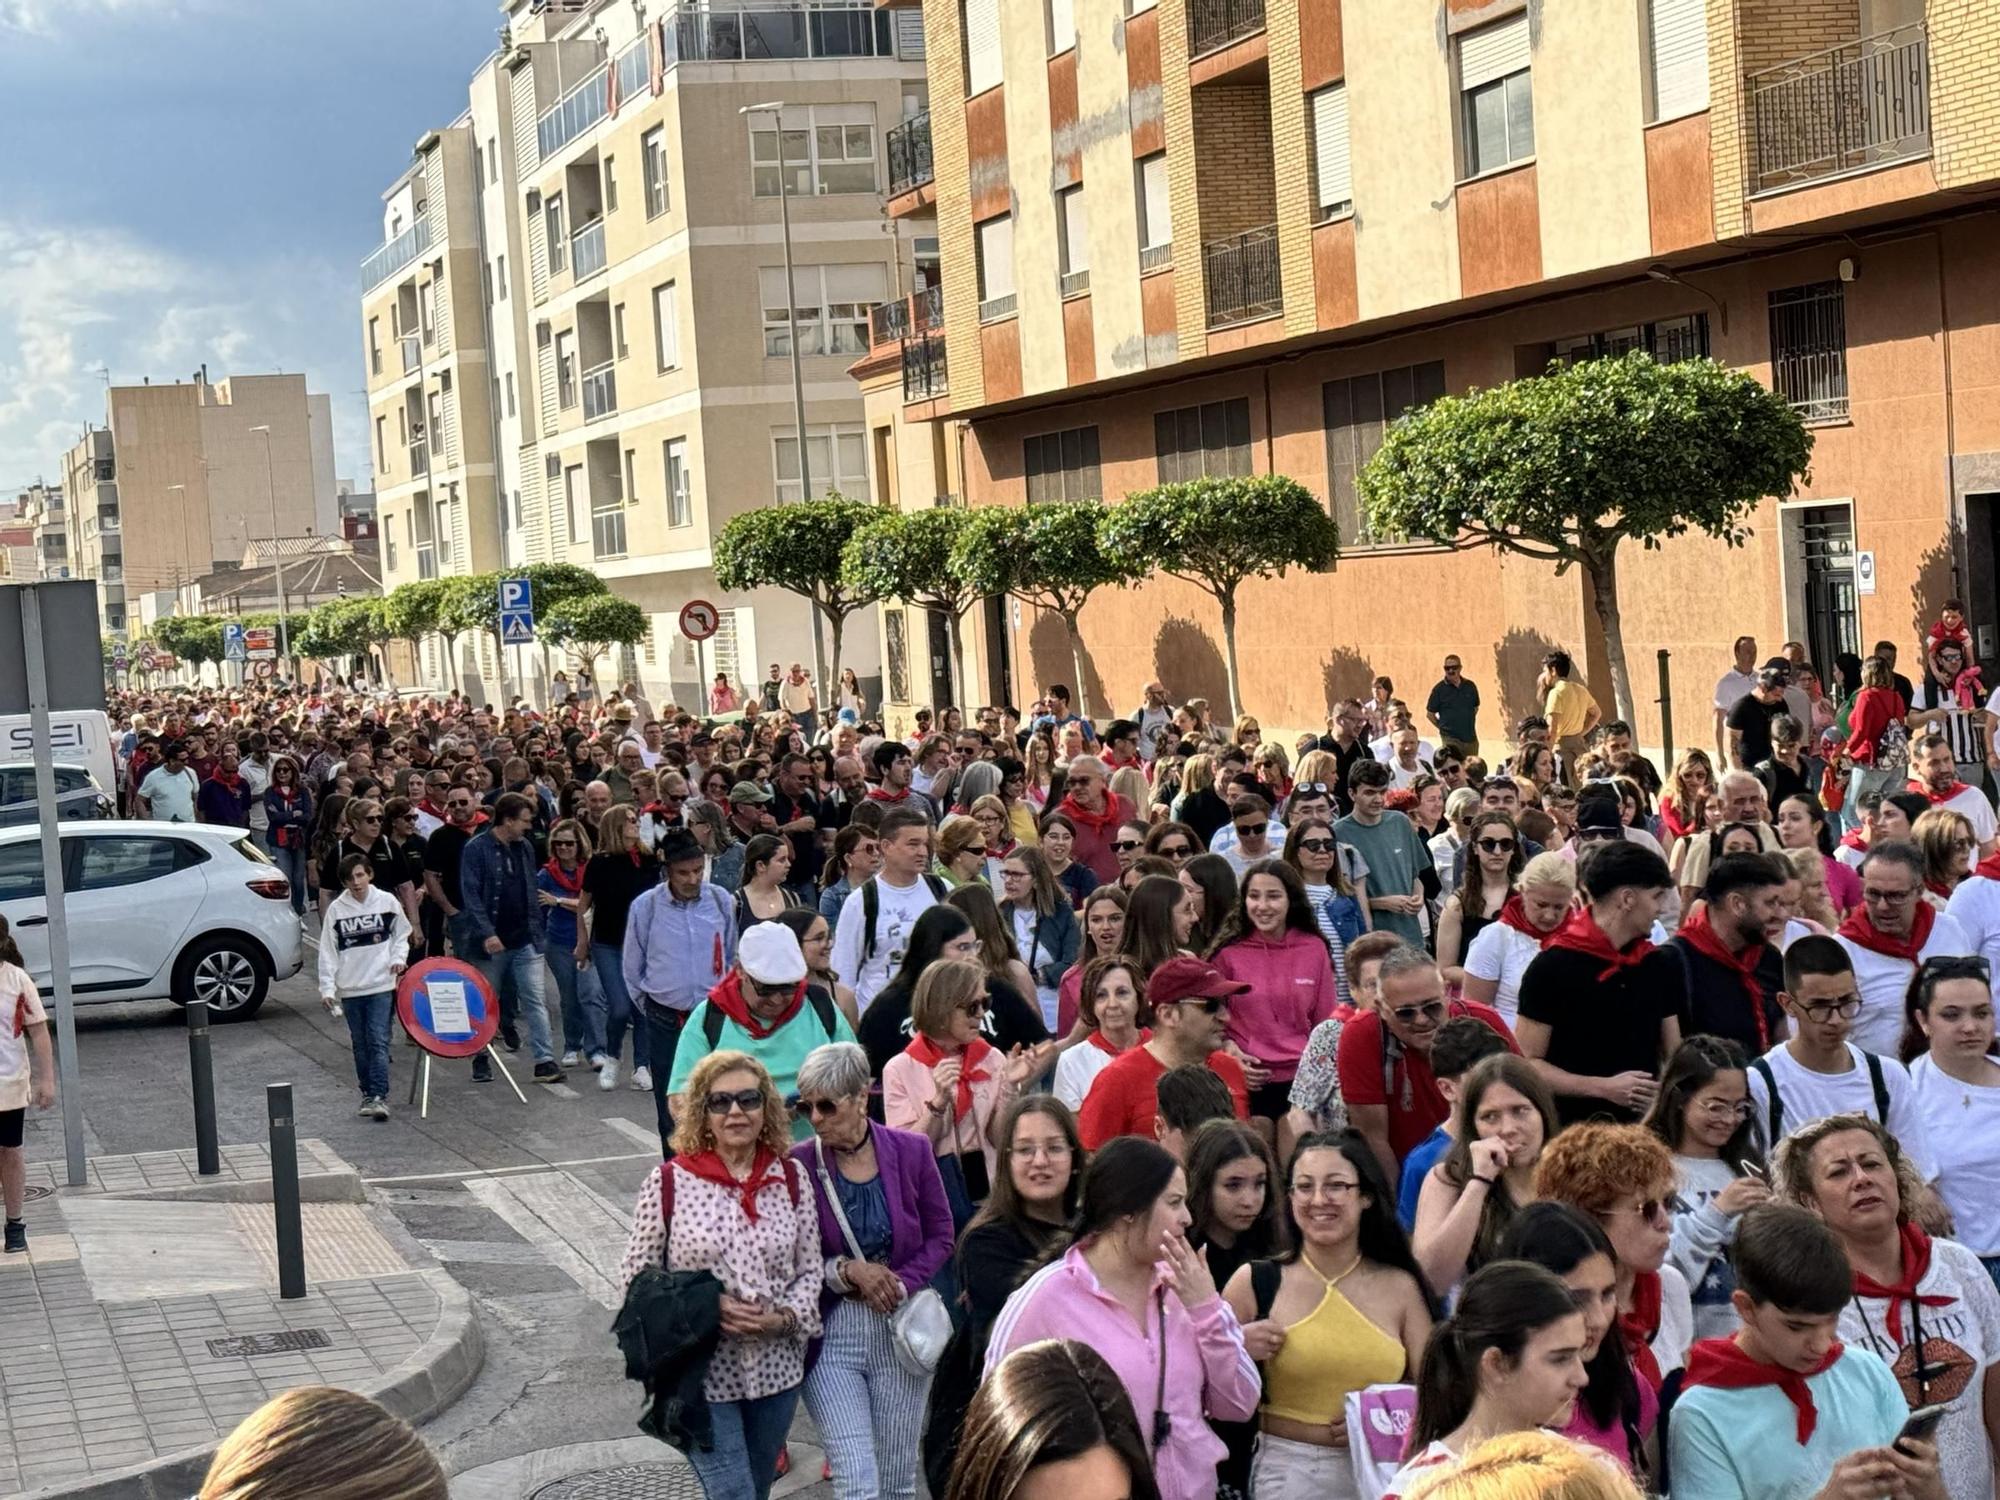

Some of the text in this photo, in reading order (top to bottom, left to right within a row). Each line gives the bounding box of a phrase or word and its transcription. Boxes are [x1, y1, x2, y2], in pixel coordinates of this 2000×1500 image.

[503, 583, 522, 609] P
[226, 625, 238, 640] P
[340, 914, 384, 934] NASA
